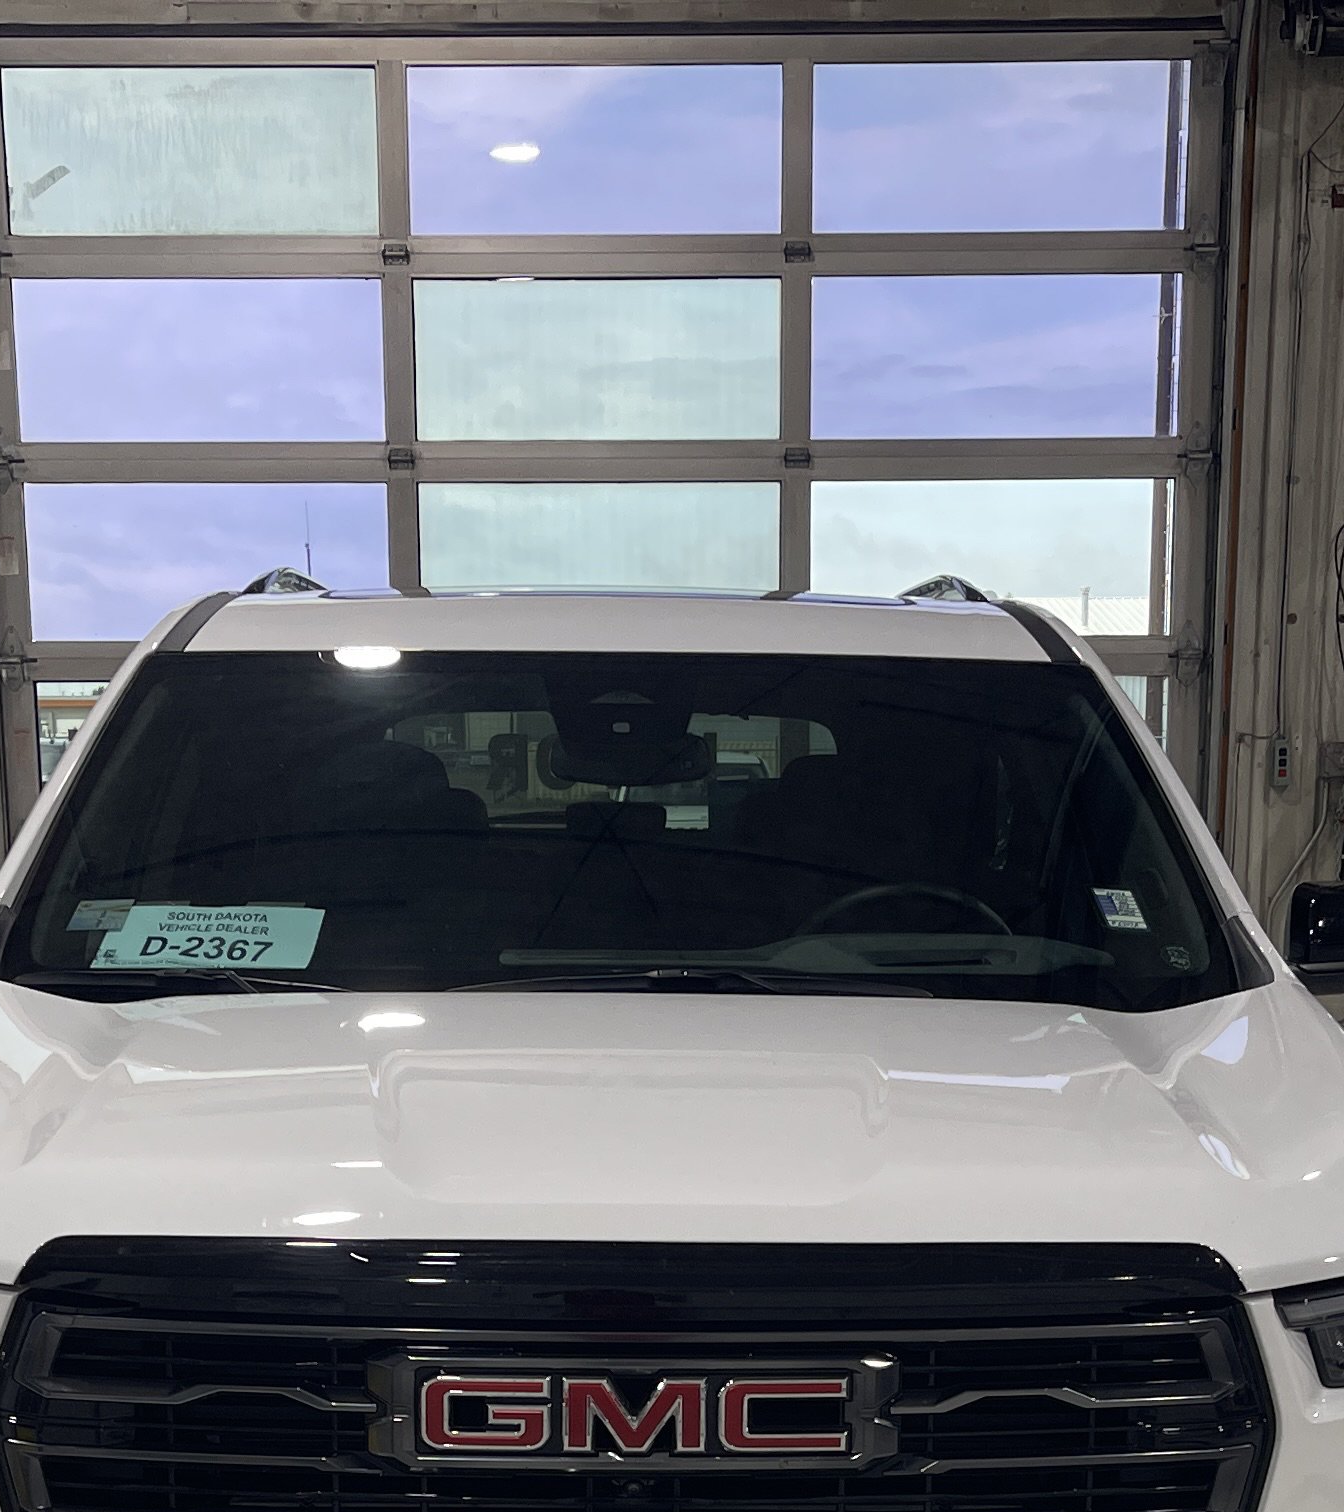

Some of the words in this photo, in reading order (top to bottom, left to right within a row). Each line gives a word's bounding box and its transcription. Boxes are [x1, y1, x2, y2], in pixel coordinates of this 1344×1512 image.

[167, 911, 212, 922] SOUTH
[214, 912, 268, 923] DAKOTA
[158, 922, 212, 933] VEHICLE
[216, 923, 270, 936] DEALER
[139, 936, 274, 963] D-2367
[420, 1374, 849, 1453] GMC
